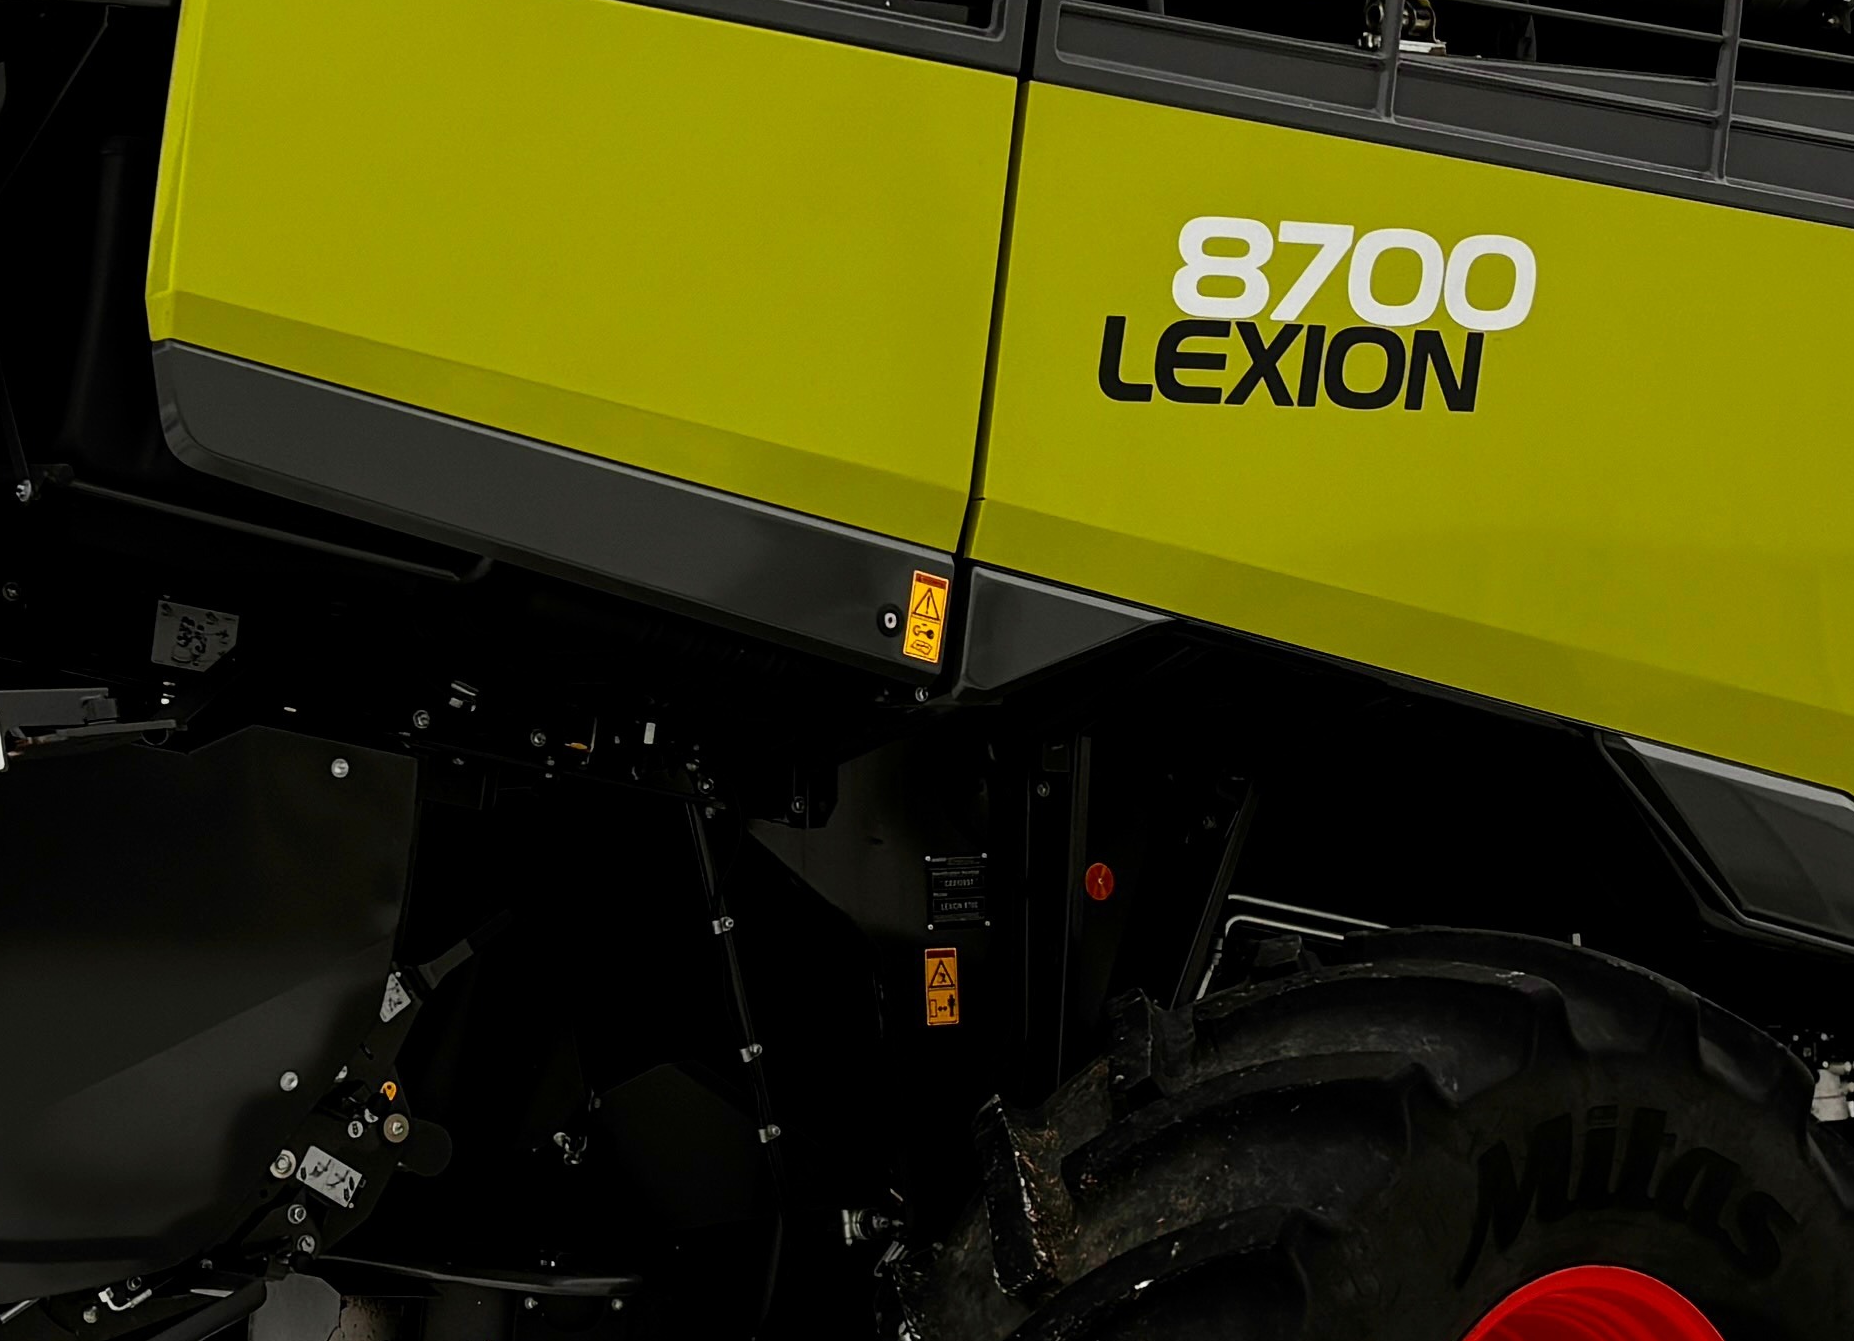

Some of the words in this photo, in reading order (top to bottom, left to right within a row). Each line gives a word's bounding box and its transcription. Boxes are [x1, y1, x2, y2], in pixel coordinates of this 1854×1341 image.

[1171, 216, 1537, 331] 8700
[1098, 315, 1485, 413] LEXION
[1456, 1105, 1804, 1290] Mitas
